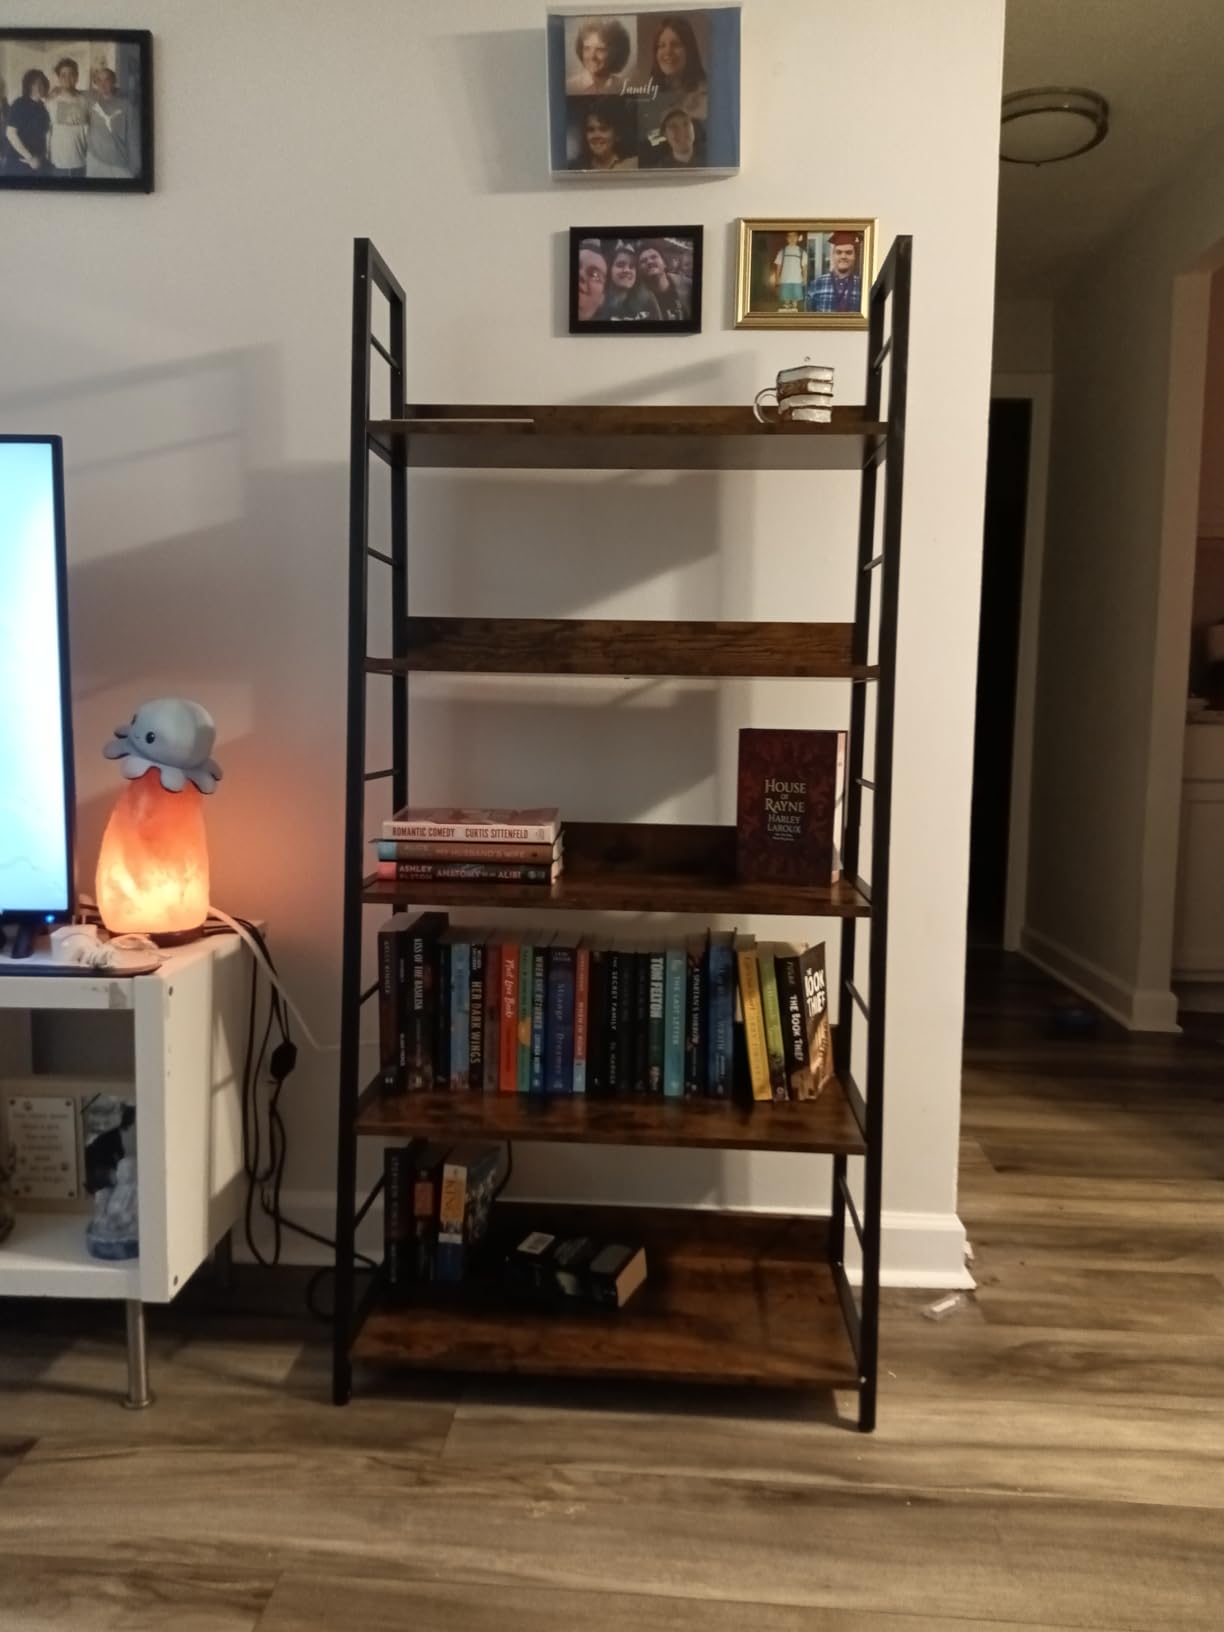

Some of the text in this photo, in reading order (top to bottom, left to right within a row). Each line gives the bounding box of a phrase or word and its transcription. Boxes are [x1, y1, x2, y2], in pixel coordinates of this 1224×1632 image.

[764, 778, 807, 794] HOUSE
[764, 797, 807, 814] RAYNE
[768, 814, 801, 824] HARLEY
[392, 826, 529, 840] ROMANTIC COMEDY CURTIS SITTENFELD
[399, 865, 433, 873] ASHLEY
[413, 938, 424, 953] KISS
[413, 954, 424, 963] OF
[534, 955, 544, 977] WHEN
[413, 965, 424, 978] THE
[471, 981, 483, 1000] HER
[610, 970, 619, 1000] SECRET
[649, 957, 664, 1019] TOM FELTON
[672, 975, 681, 1046] THE LAST LETTER
[789, 994, 799, 1013] THE
[806, 990, 827, 1018] THIEF
[471, 1002, 483, 1029] DARK
[609, 1002, 618, 1031] FAMILY
[790, 1013, 801, 1037] BOOK
[470, 1031, 482, 1064] WINGS
[792, 1039, 804, 1061] THIEF
